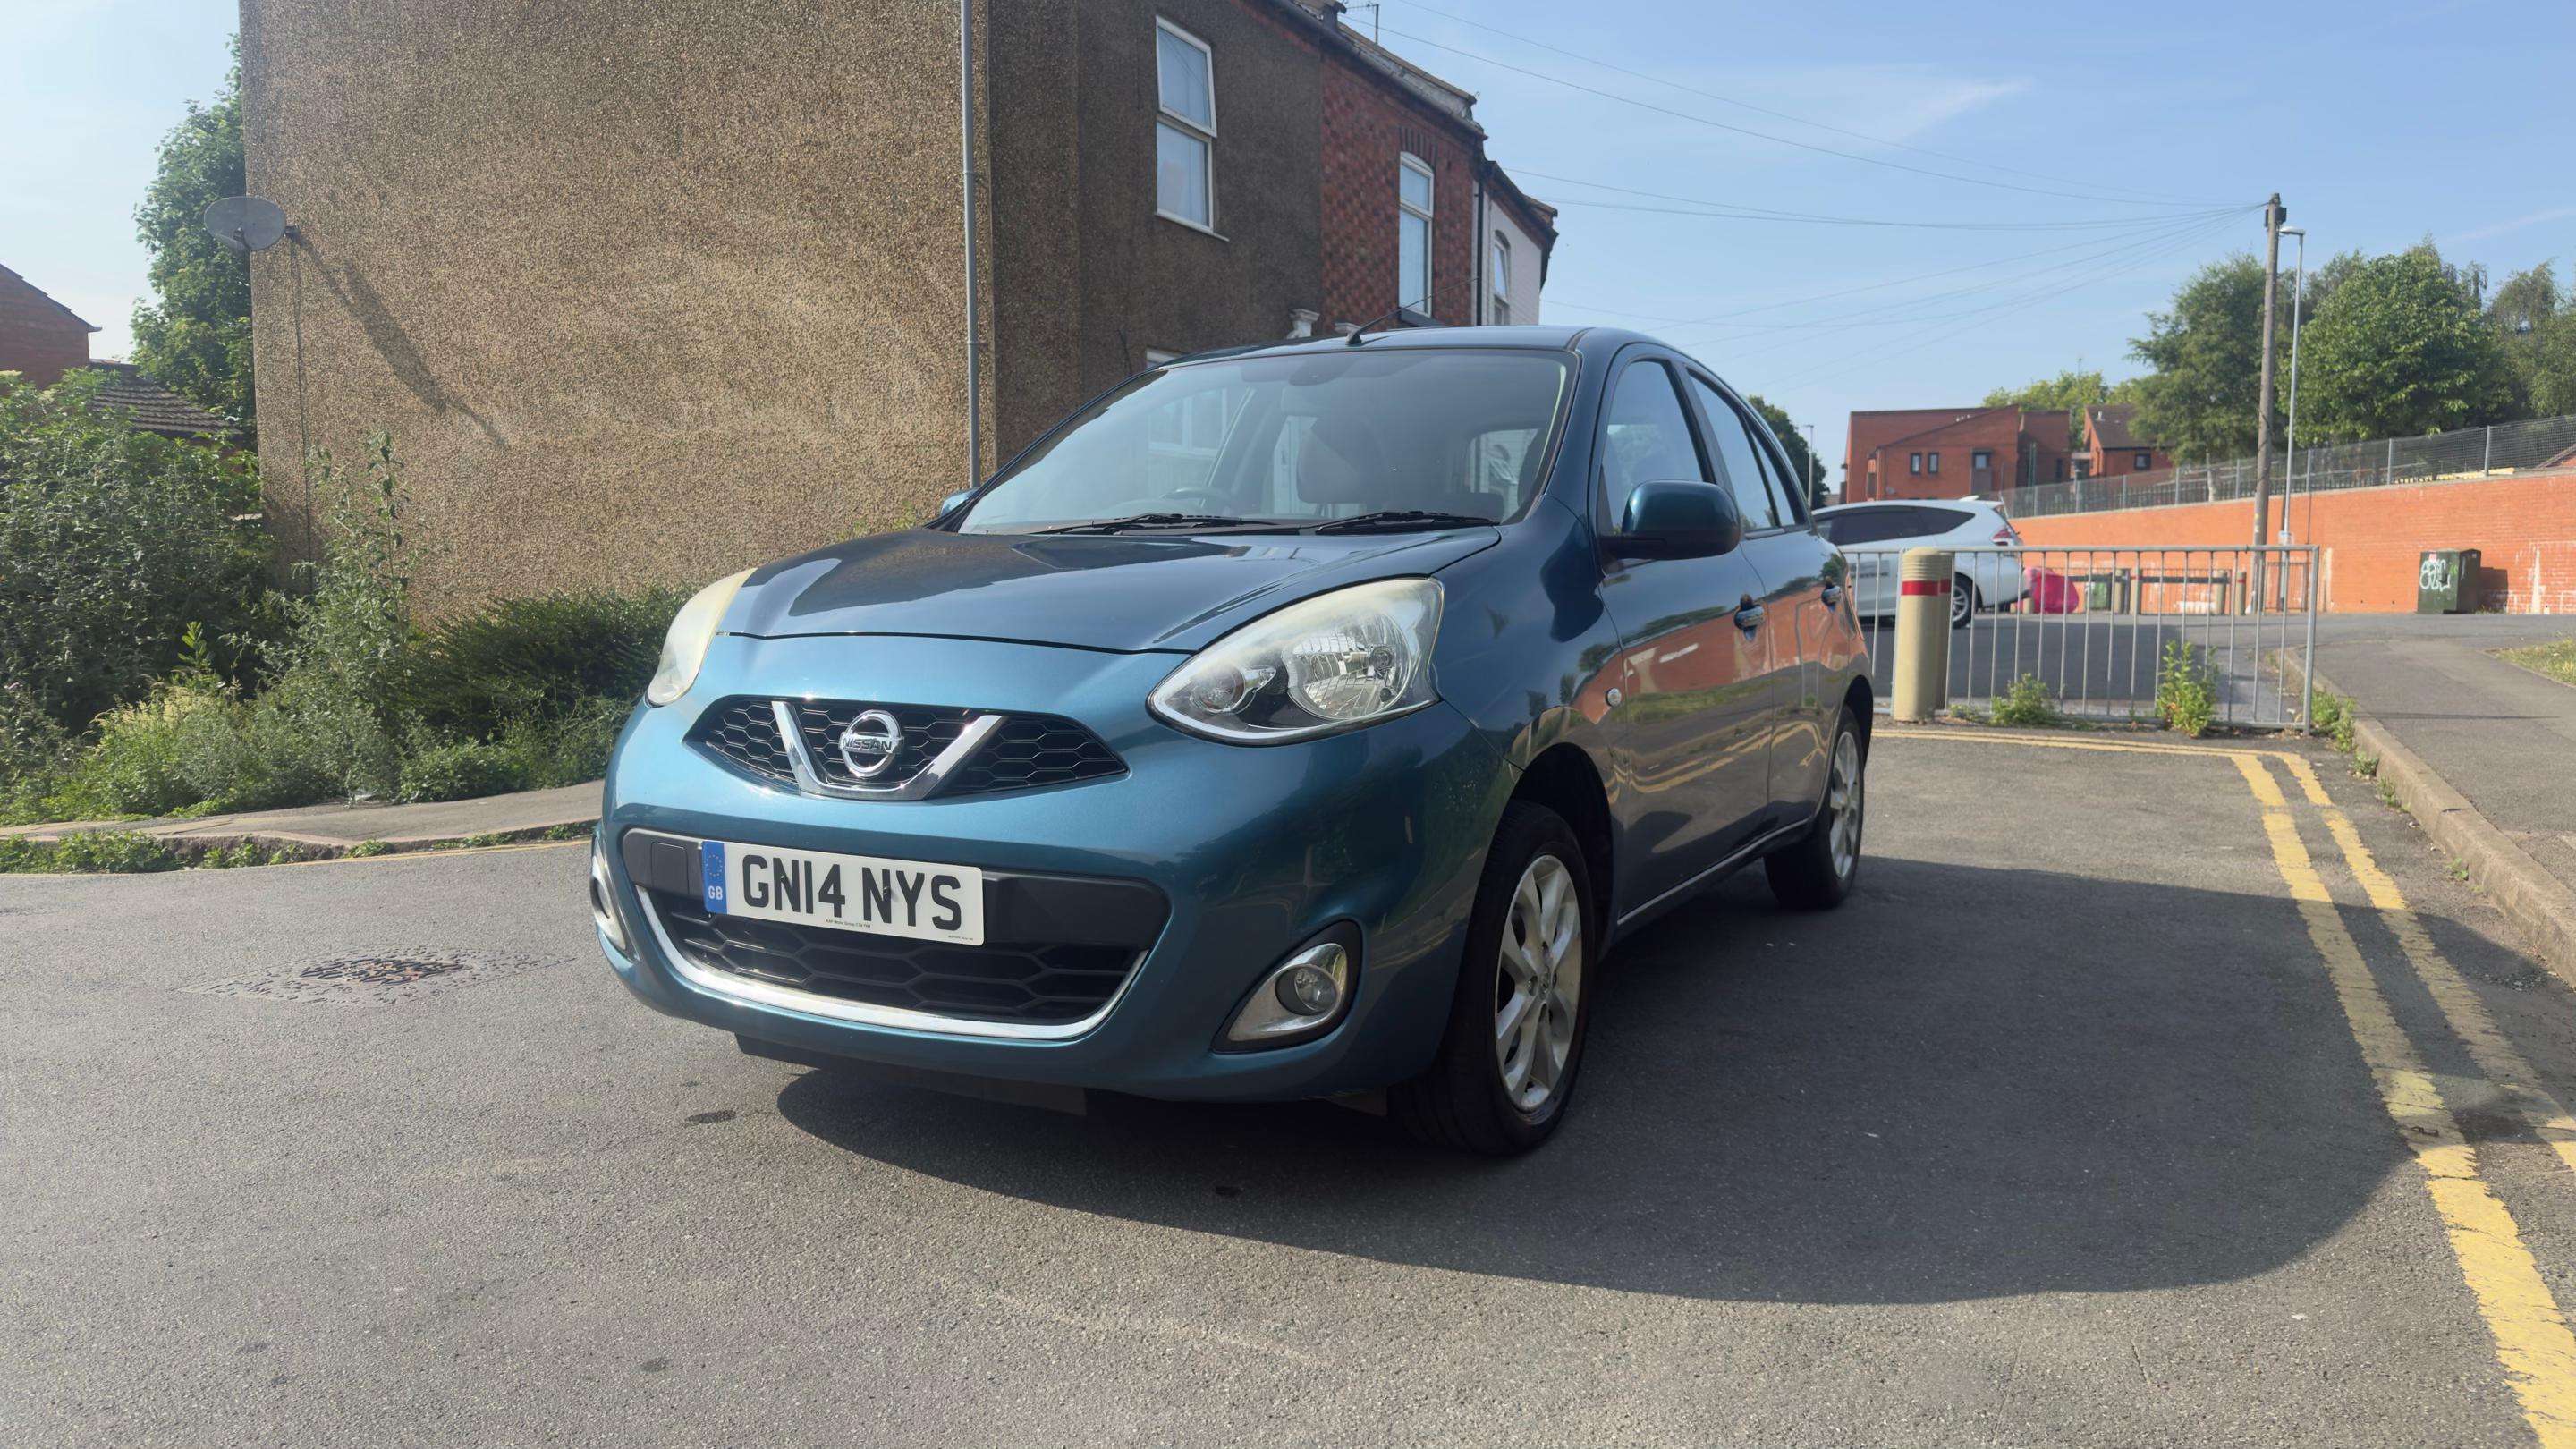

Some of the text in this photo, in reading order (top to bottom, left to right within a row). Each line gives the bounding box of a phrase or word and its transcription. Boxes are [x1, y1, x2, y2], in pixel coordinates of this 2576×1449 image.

[843, 737, 892, 750] NISSAN
[708, 886, 723, 901] GB
[742, 854, 962, 931] GN14 NYS
